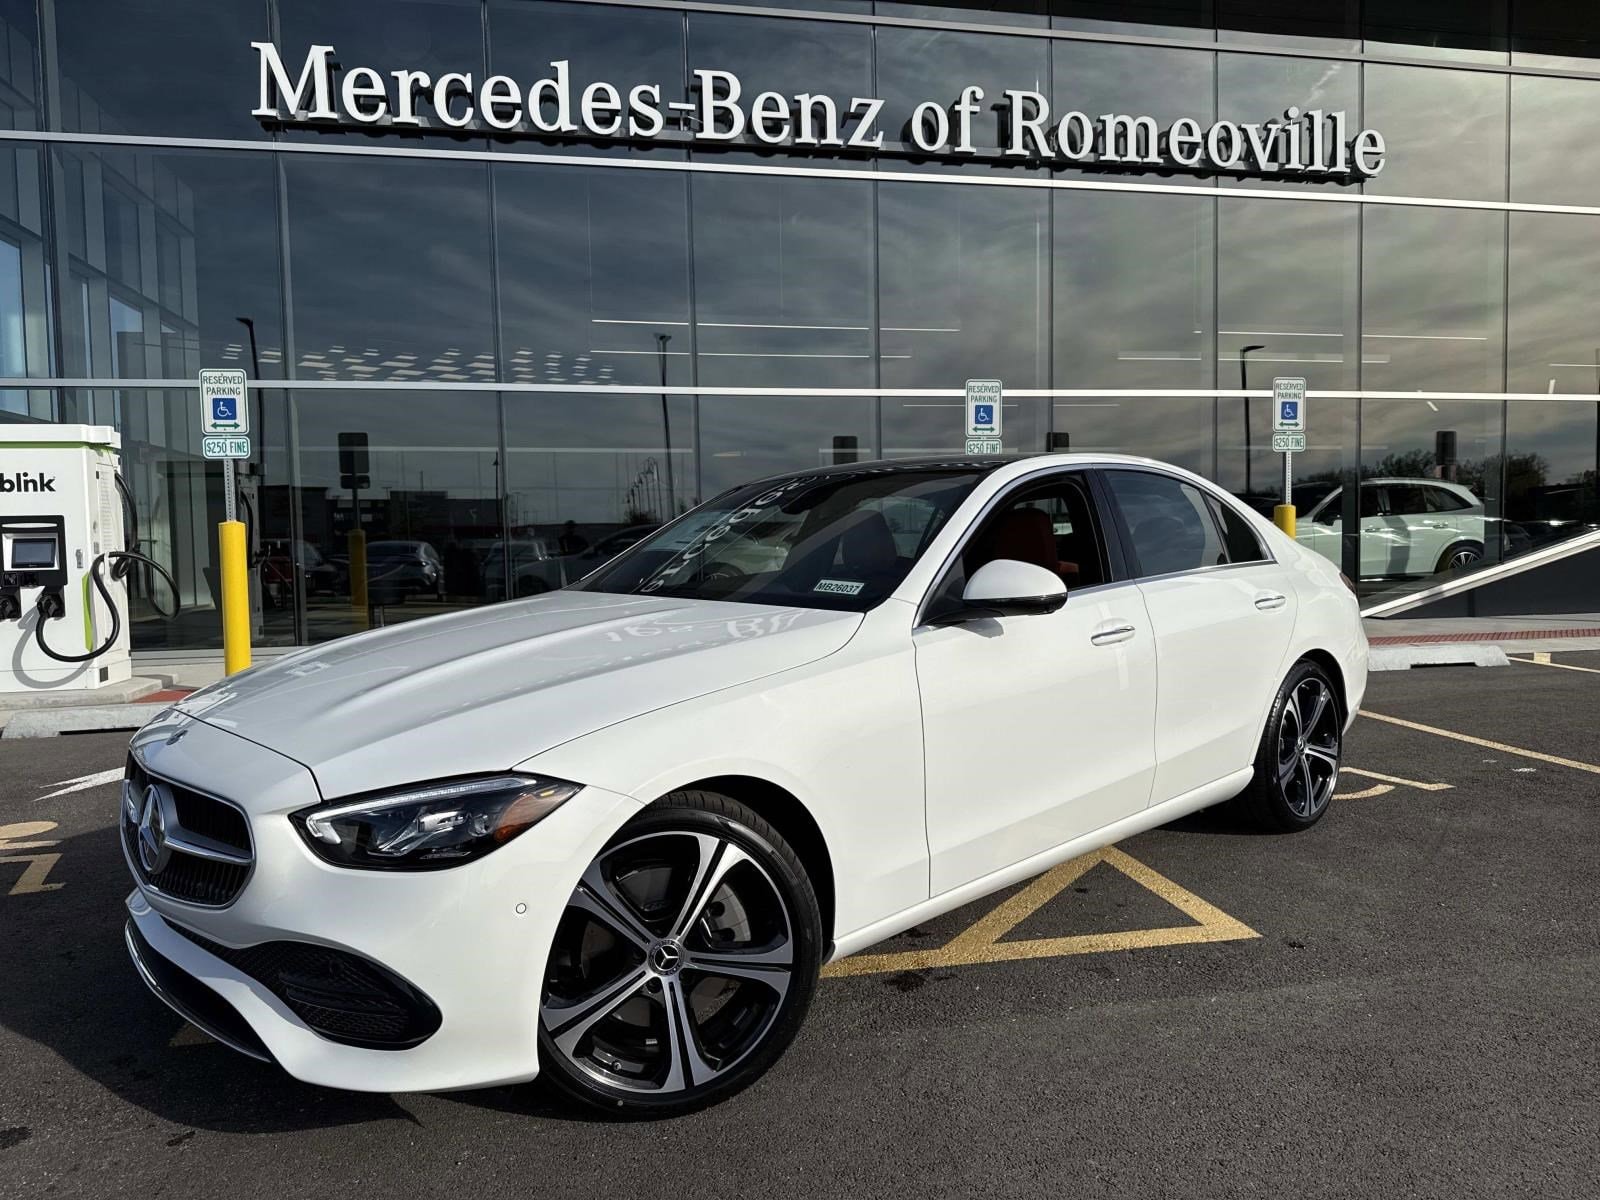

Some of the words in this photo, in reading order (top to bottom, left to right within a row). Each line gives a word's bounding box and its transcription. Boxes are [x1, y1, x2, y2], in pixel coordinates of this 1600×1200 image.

[251, 41, 883, 148] Mercedes-Benz
[911, 86, 984, 153] of
[1003, 89, 1386, 176] Romeoville
[203, 375, 243, 385] RESERVED
[968, 385, 1000, 393] RESERVED
[1275, 382, 1304, 390] RESERVED
[206, 387, 241, 396] PARKING
[1277, 392, 1302, 400] PARKING
[970, 395, 998, 403] PARKING
[206, 441, 227, 454] $250
[230, 441, 247, 454] FINE
[1275, 437, 1290, 448] $250
[1291, 437, 1303, 448] FINE
[968, 443, 985, 454] $250
[0, 471, 56, 492] blink
[815, 582, 861, 594] MB26037
